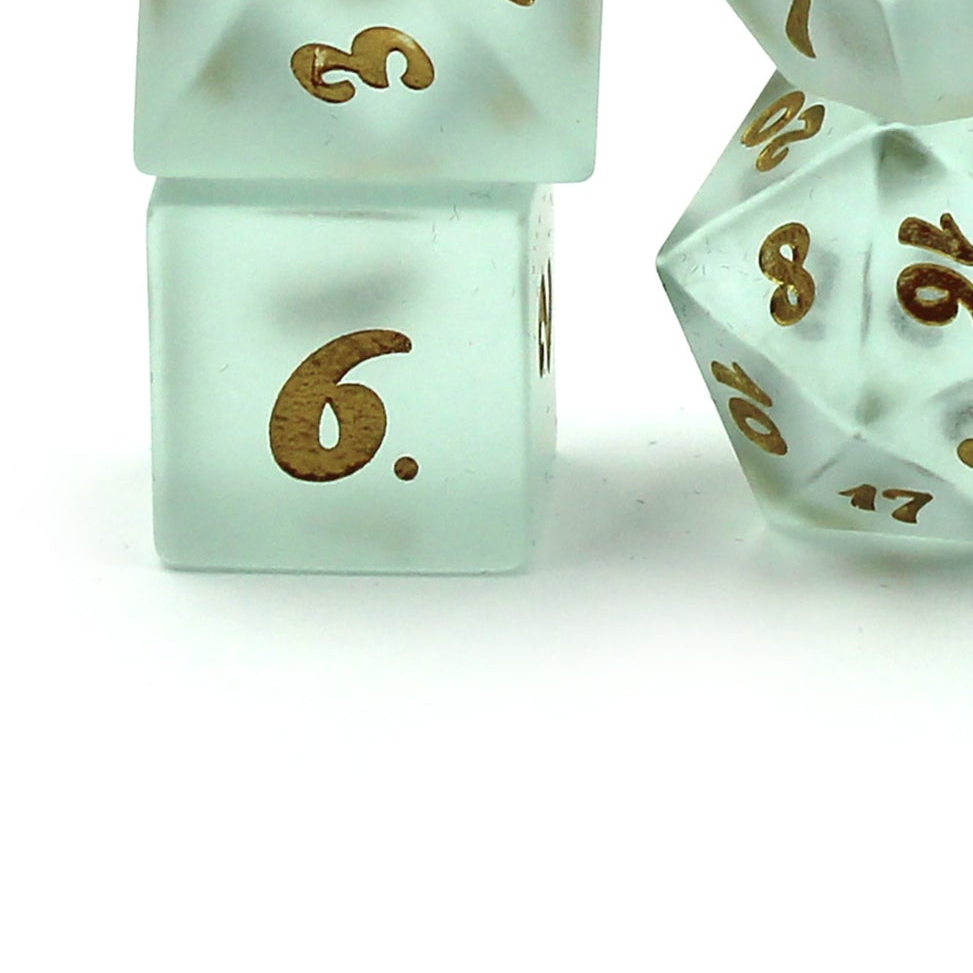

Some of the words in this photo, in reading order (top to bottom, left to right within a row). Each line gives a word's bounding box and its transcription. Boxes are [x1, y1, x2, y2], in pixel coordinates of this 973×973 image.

[290, 26, 435, 105] 3
[741, 90, 826, 173] 20
[758, 221, 816, 327] 8
[711, 360, 789, 457] 10
[837, 483, 935, 525] 17
